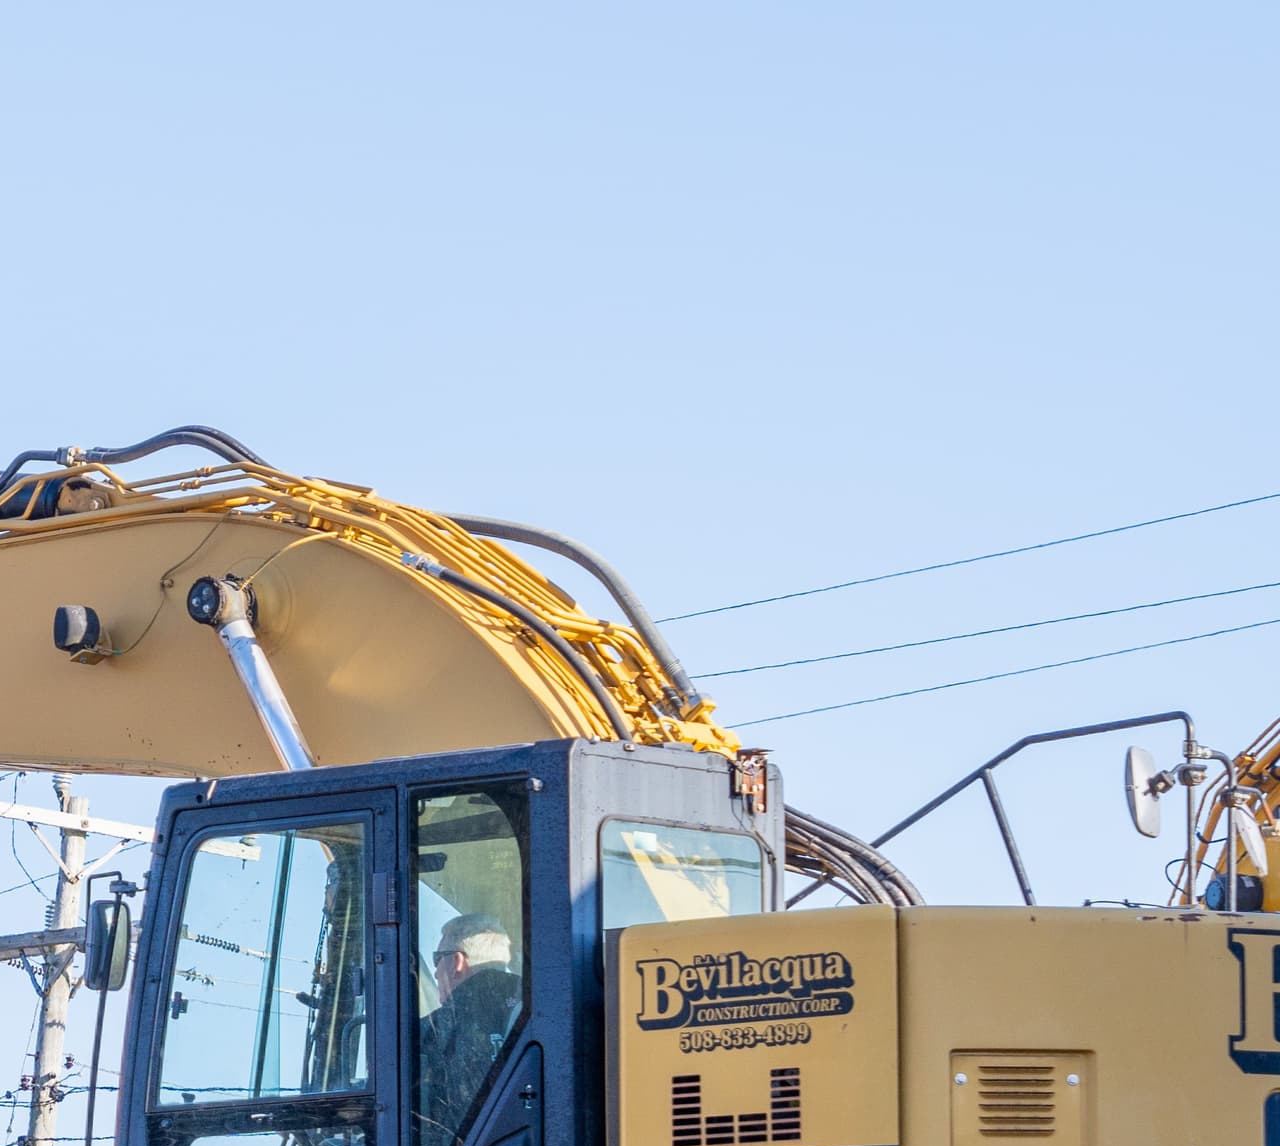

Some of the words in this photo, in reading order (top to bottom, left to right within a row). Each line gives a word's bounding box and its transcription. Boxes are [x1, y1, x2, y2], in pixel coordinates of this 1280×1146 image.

[637, 952, 852, 1028] Bevilacqua
[697, 1003, 799, 1022] CONSTRUCTION
[802, 998, 843, 1013] CORP.
[680, 1023, 811, 1053] 508-833-4899
